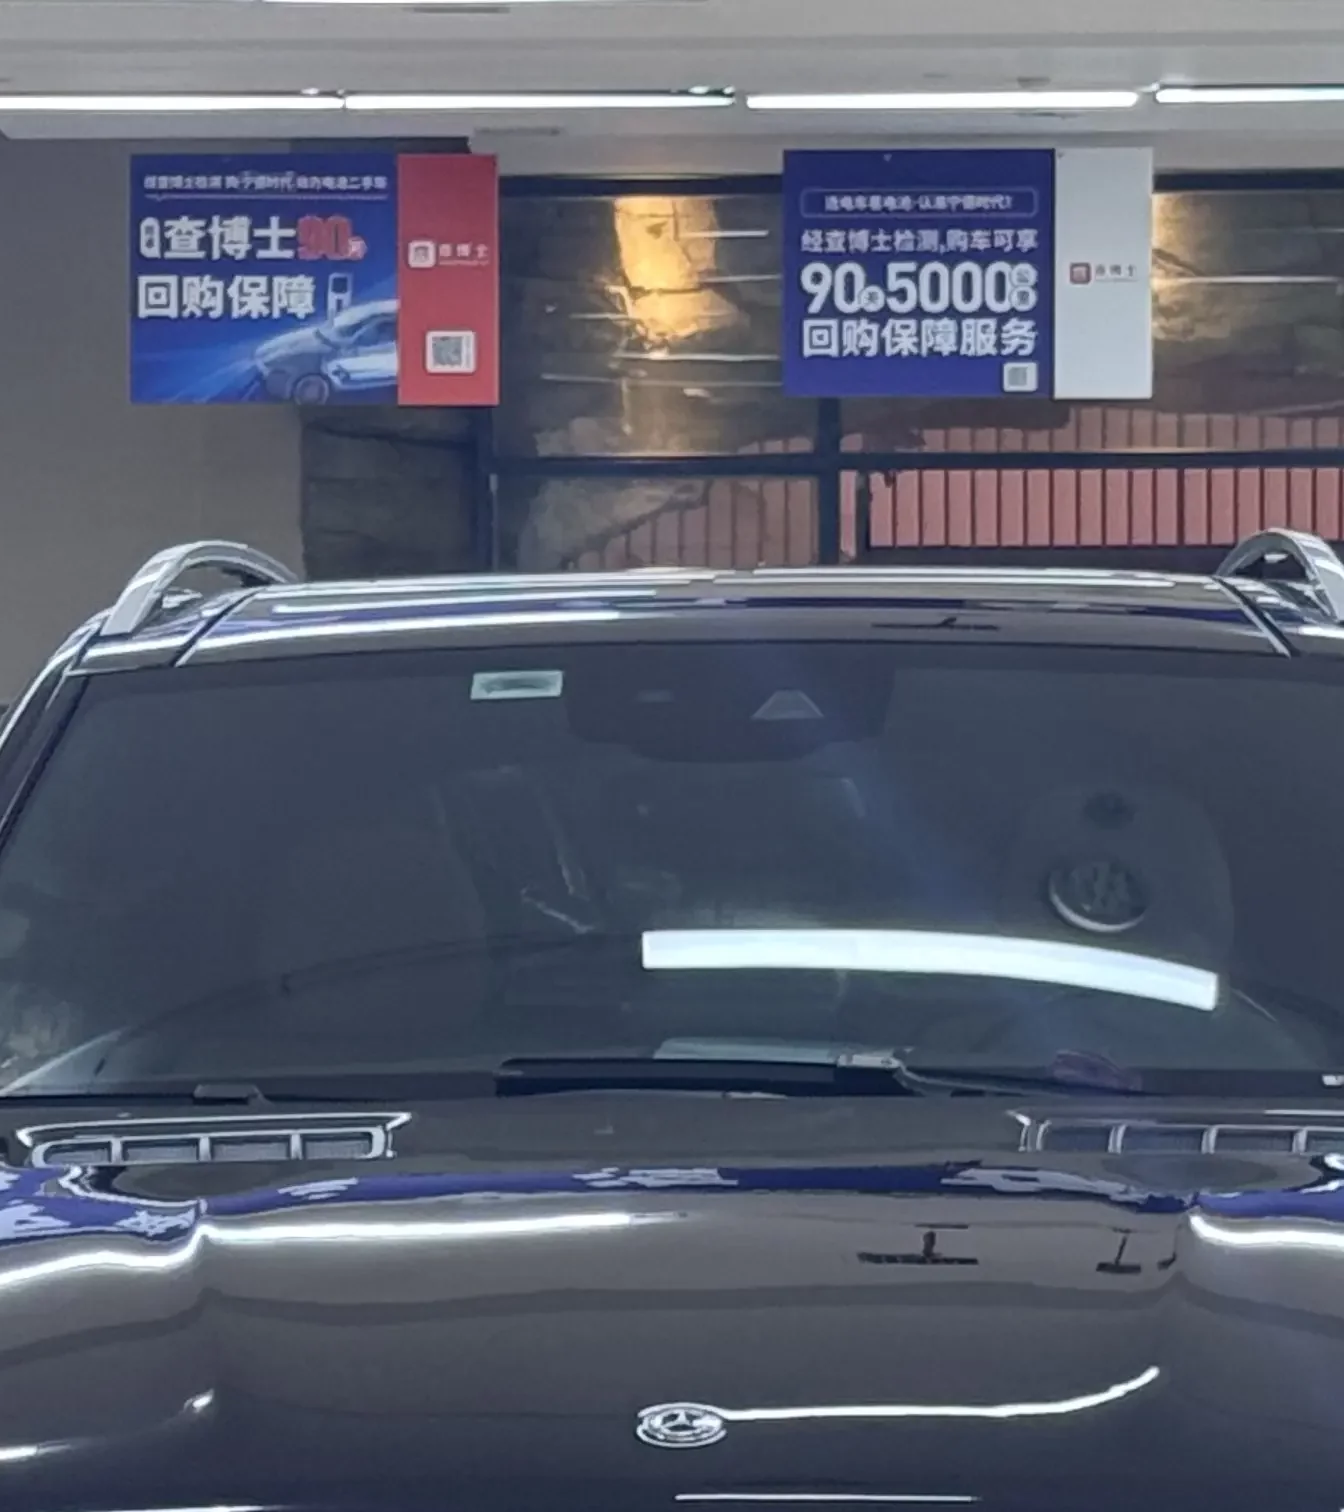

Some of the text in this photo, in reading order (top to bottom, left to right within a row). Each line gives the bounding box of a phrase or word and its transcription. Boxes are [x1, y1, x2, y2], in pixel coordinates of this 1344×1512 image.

[137, 273, 315, 319] 回购保障
[802, 318, 1039, 358] 回购保障服务
